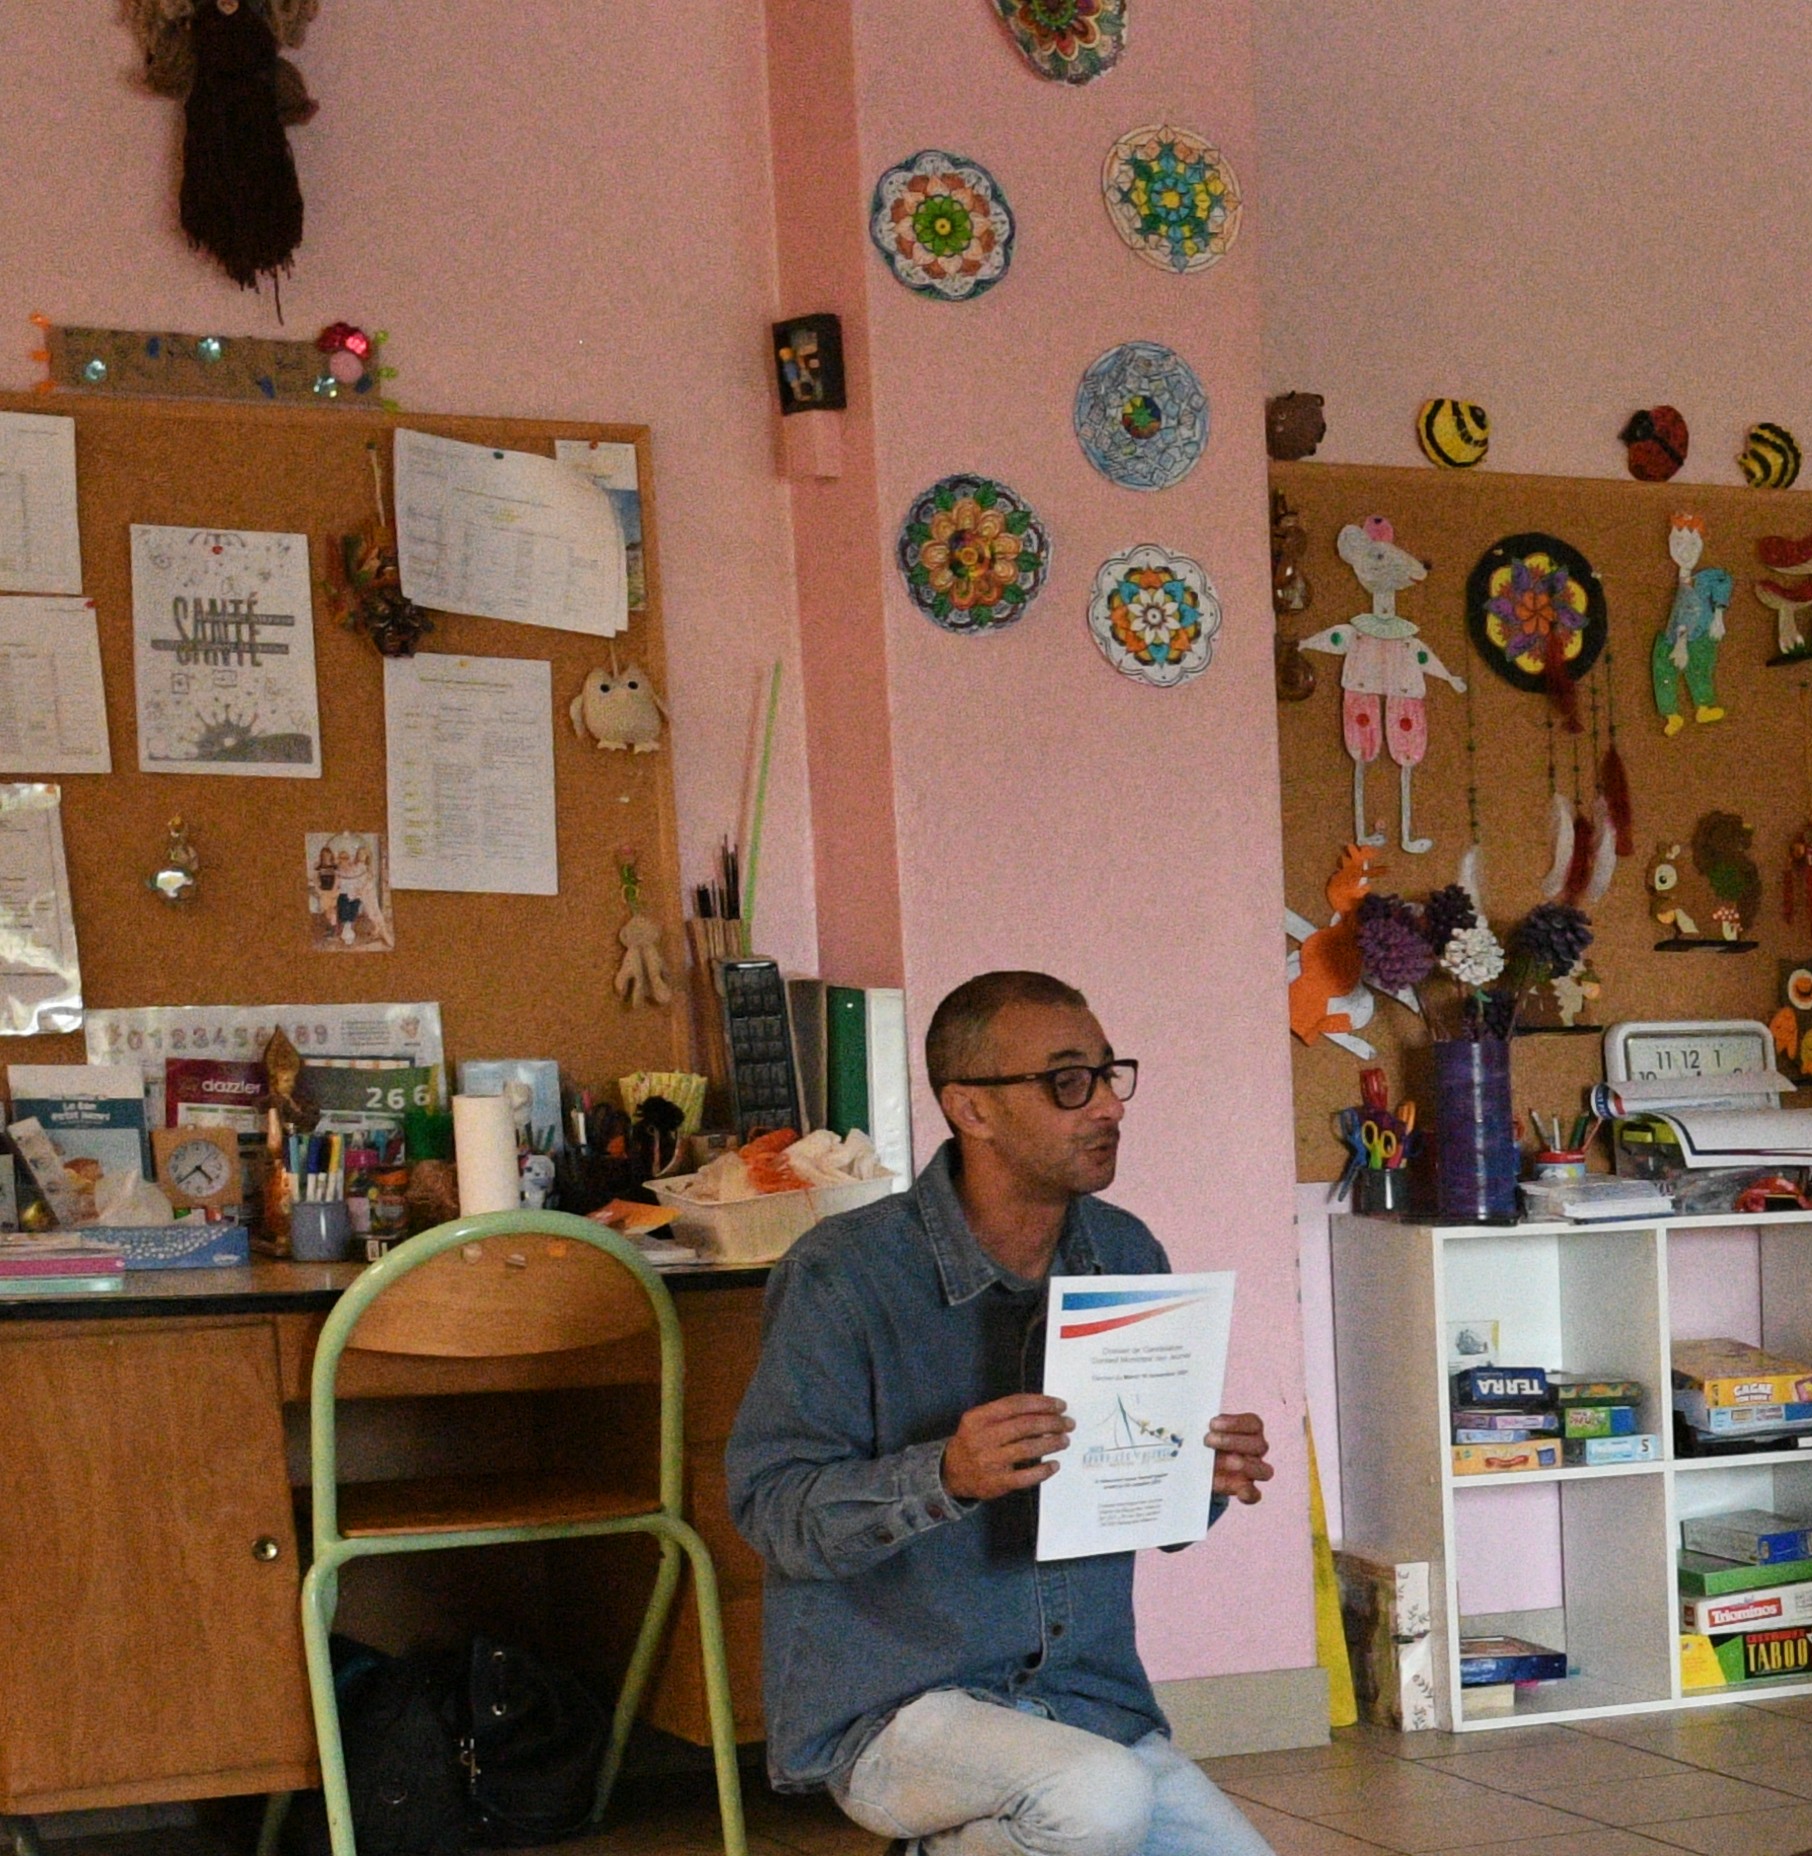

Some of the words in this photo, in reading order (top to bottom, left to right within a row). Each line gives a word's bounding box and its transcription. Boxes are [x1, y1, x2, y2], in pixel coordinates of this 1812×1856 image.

[1656, 1051, 1672, 1070] 11
[1681, 1050, 1700, 1070] 12
[1714, 1050, 1722, 1068] 1
[201, 1078, 261, 1096] dazzler
[1477, 1379, 1545, 1396] TERRA
[1712, 1604, 1778, 1624] Triominos
[1747, 1638, 1808, 1672] TABOO
